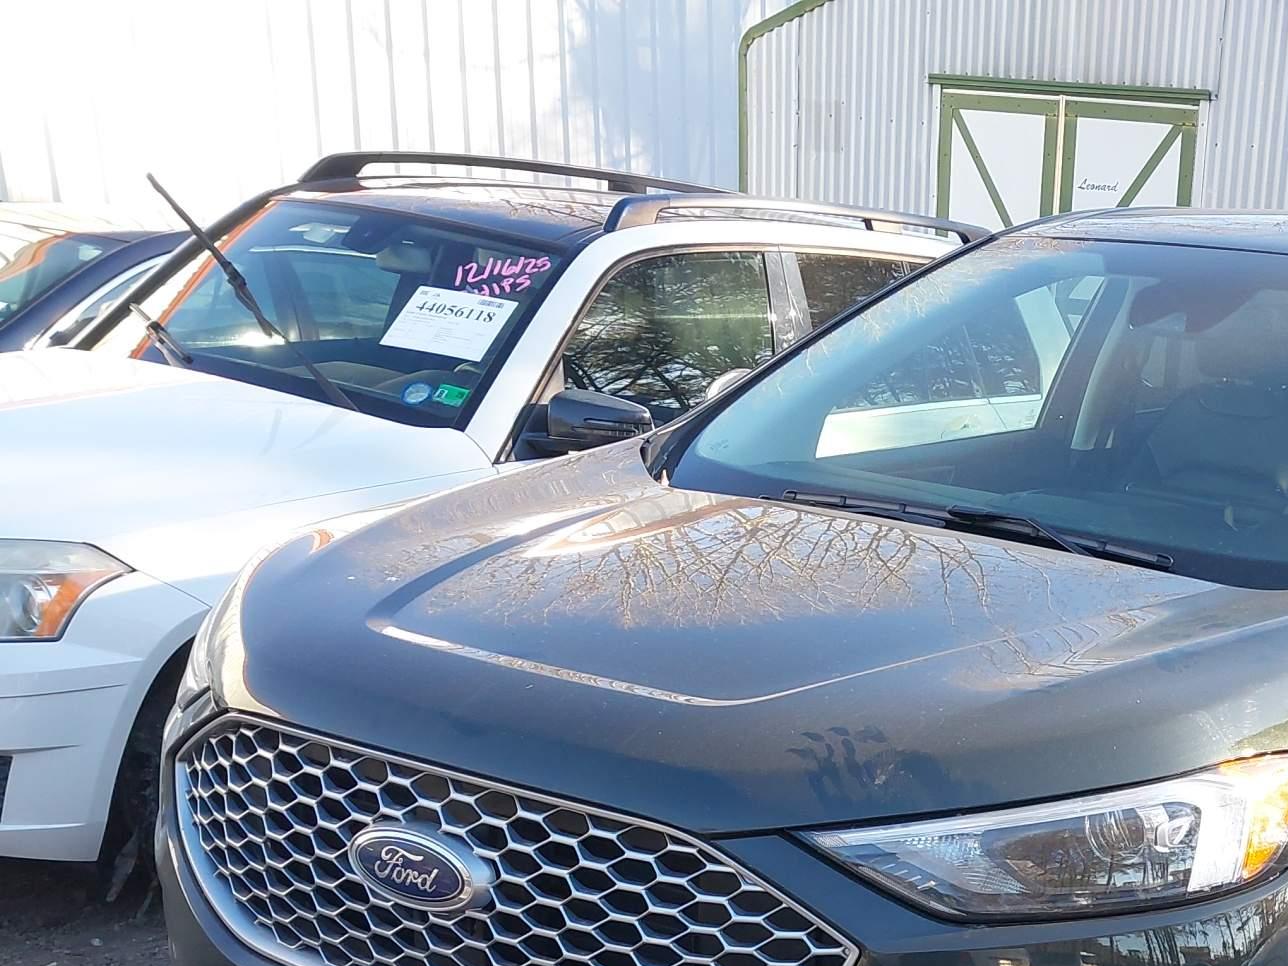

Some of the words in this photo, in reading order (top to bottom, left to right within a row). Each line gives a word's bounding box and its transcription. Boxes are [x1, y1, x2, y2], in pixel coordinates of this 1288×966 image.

[1077, 178, 1119, 192] Leonard
[454, 256, 551, 287] 12/16/25
[416, 300, 496, 324] 44056118
[374, 845, 440, 893] Ford
